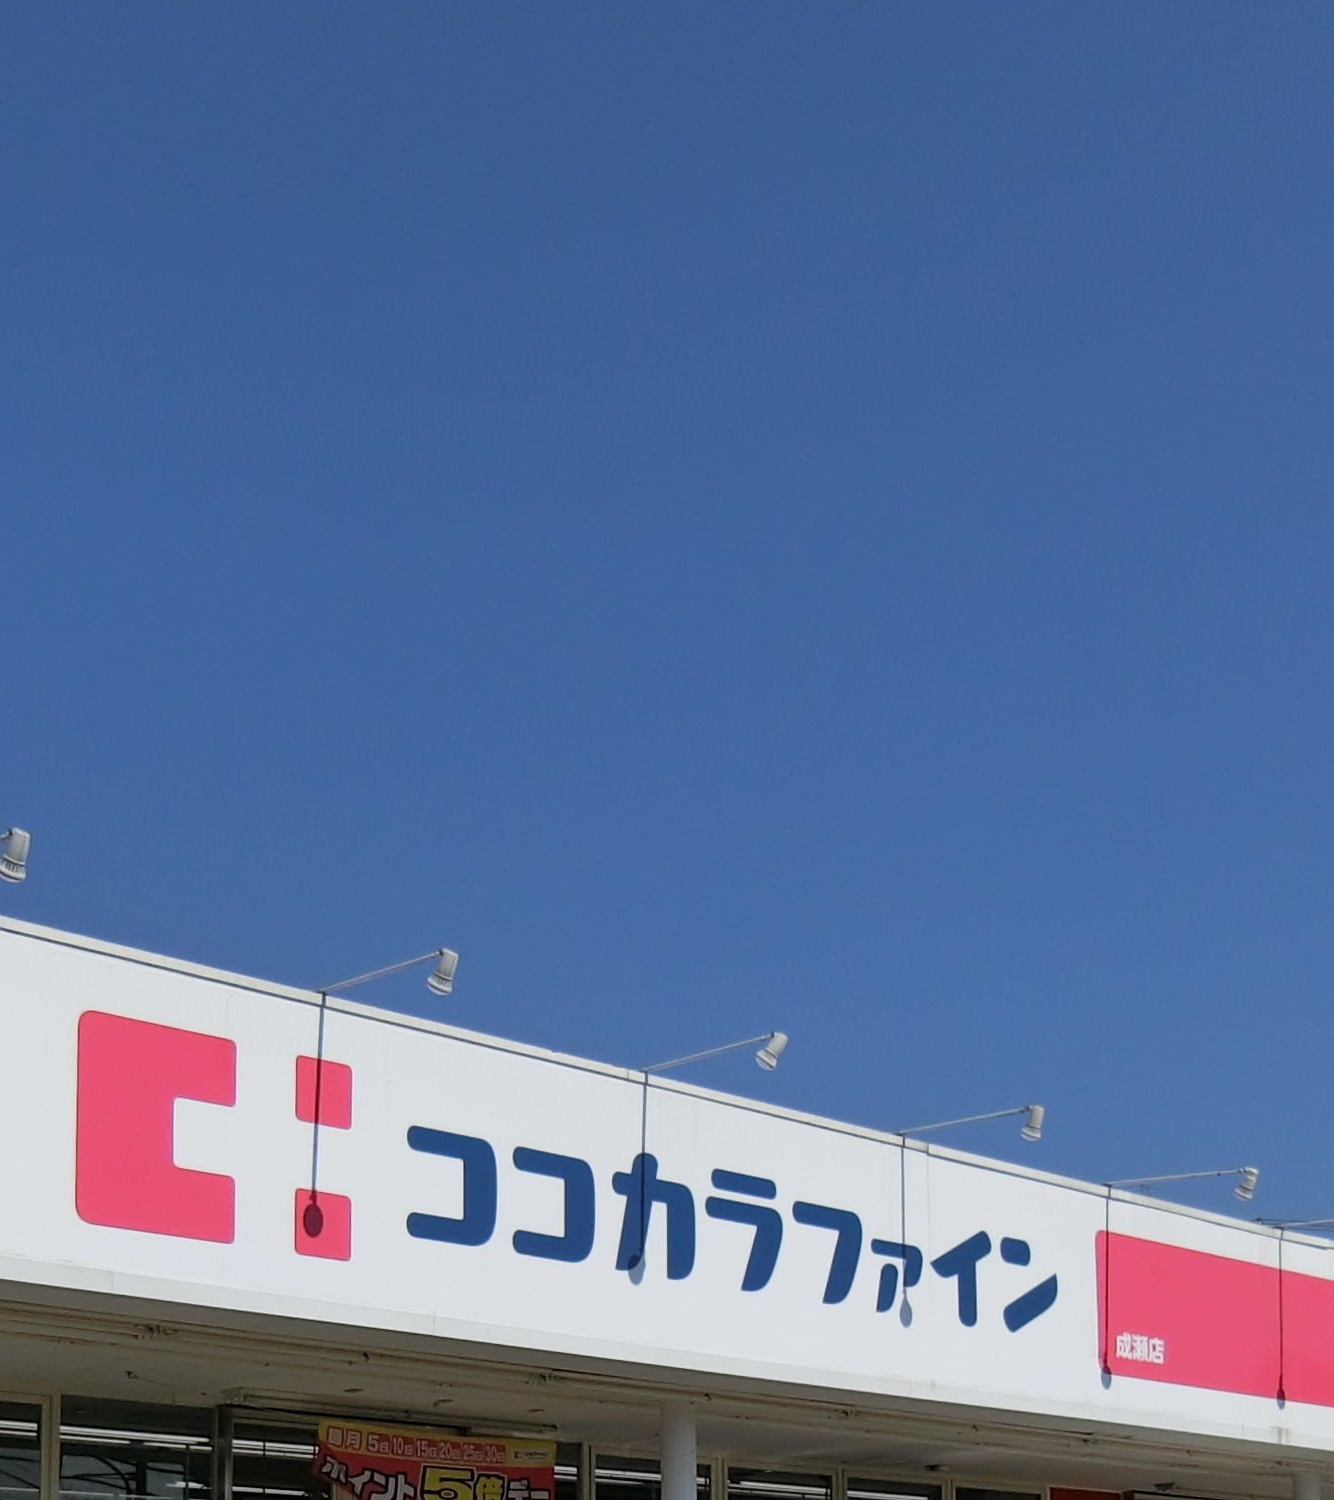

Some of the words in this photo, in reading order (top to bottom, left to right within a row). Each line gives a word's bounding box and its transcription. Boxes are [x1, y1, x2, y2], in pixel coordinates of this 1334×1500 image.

[407, 1125, 1058, 1333] ココカラファイン
[1115, 1332, 1164, 1364] 成瀬店
